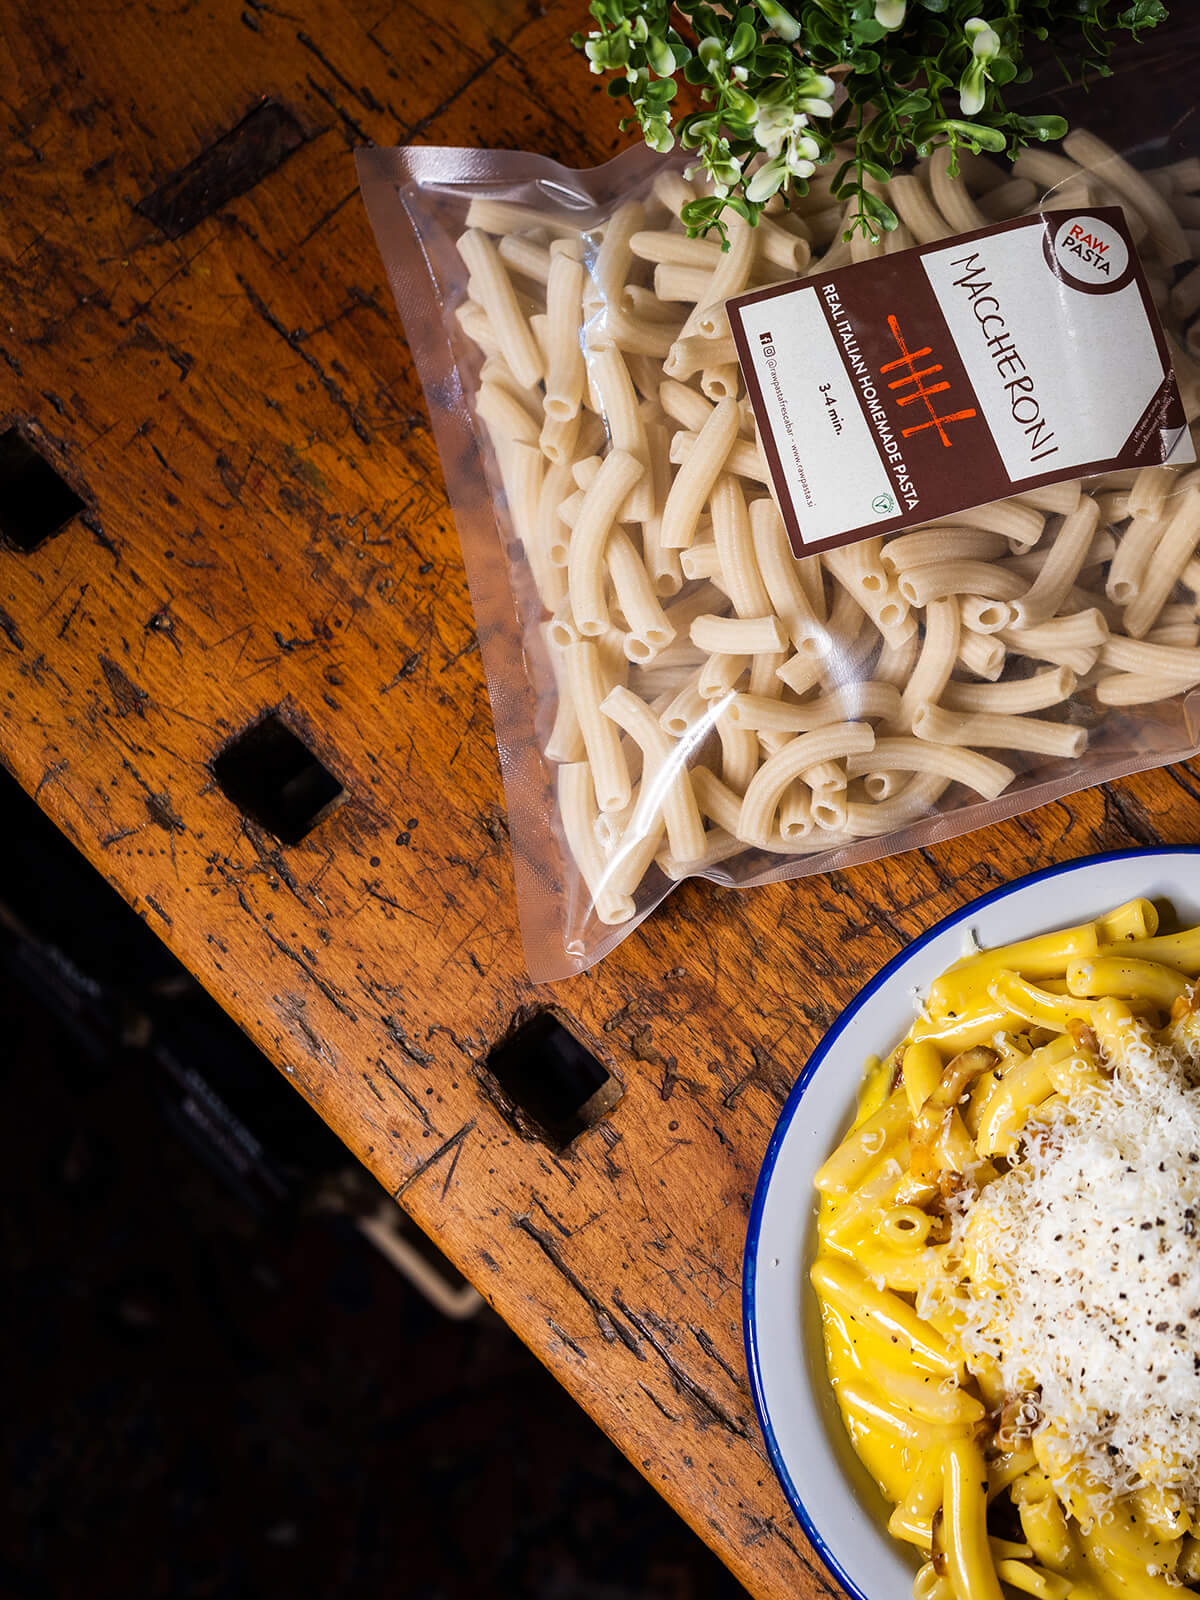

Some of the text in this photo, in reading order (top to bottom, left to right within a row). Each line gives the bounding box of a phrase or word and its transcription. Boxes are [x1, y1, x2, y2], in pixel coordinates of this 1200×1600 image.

[1061, 236, 1110, 276] PASTA
[1069, 224, 1110, 254] RAW
[822, 283, 843, 321] REAL
[836, 320, 868, 378] ITALIAN
[858, 376, 902, 464] HOMEMADE
[892, 462, 920, 512] PASTA
[950, 252, 1060, 462] MACCHERONI
[765, 358, 794, 437] @rawpastafrescabar
[791, 443, 817, 508] www.rawpasta.si
[818, 382, 845, 437] 3-4 min.
